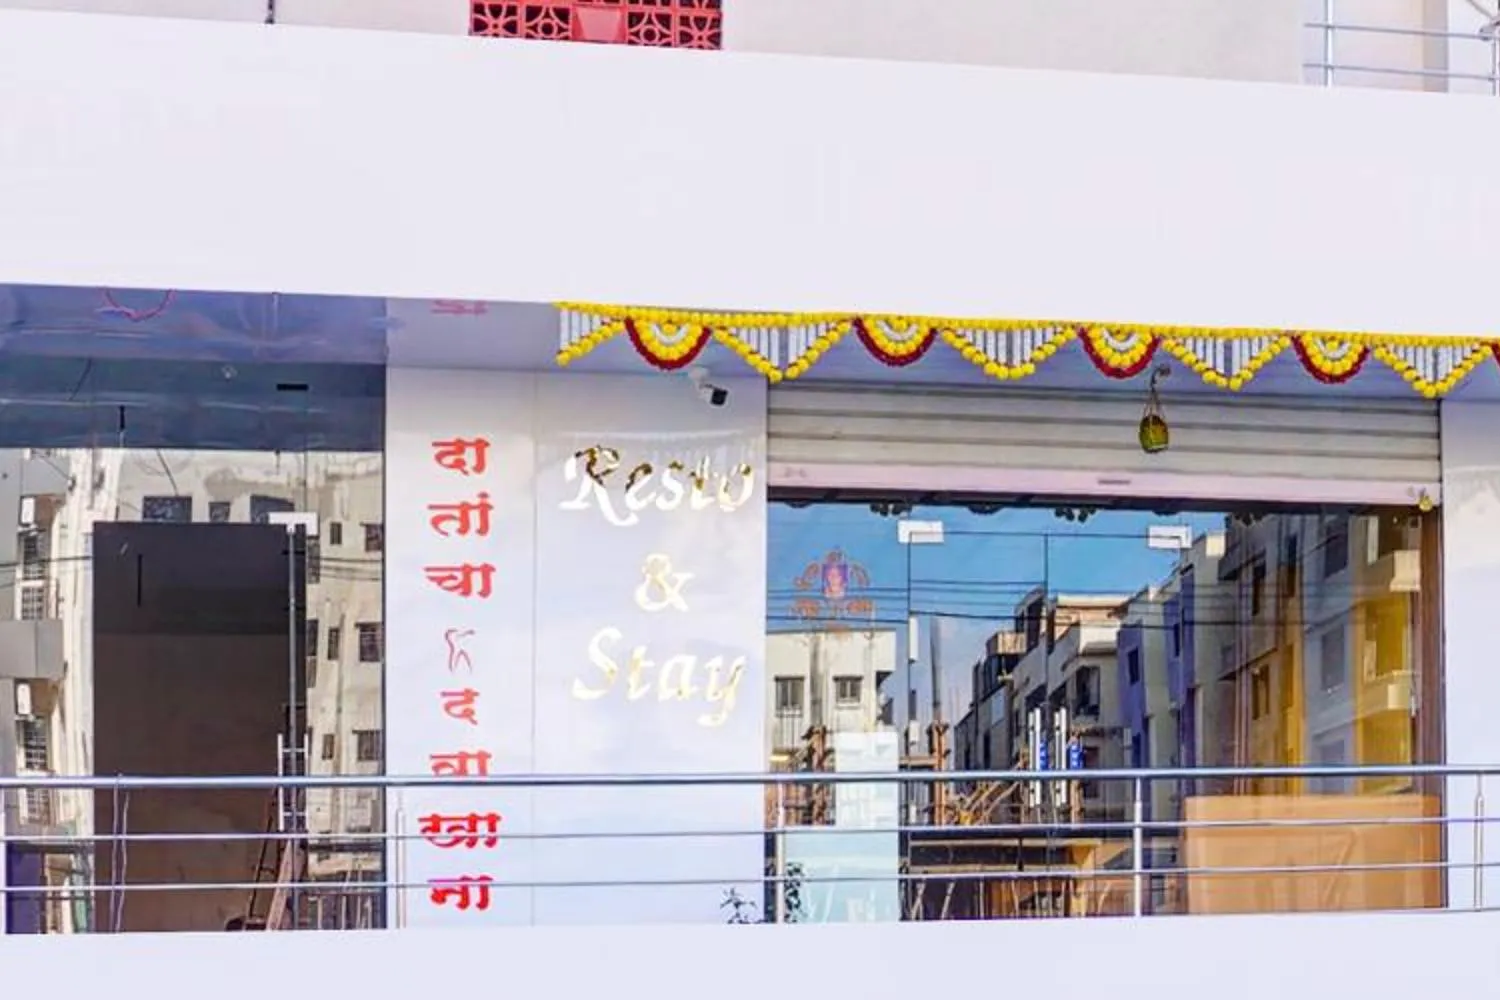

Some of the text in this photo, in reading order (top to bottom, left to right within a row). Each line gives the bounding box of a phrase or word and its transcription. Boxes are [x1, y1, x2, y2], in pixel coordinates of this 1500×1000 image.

[558, 444, 756, 527] Resto
[635, 553, 695, 612] &
[572, 627, 746, 727] Stay
